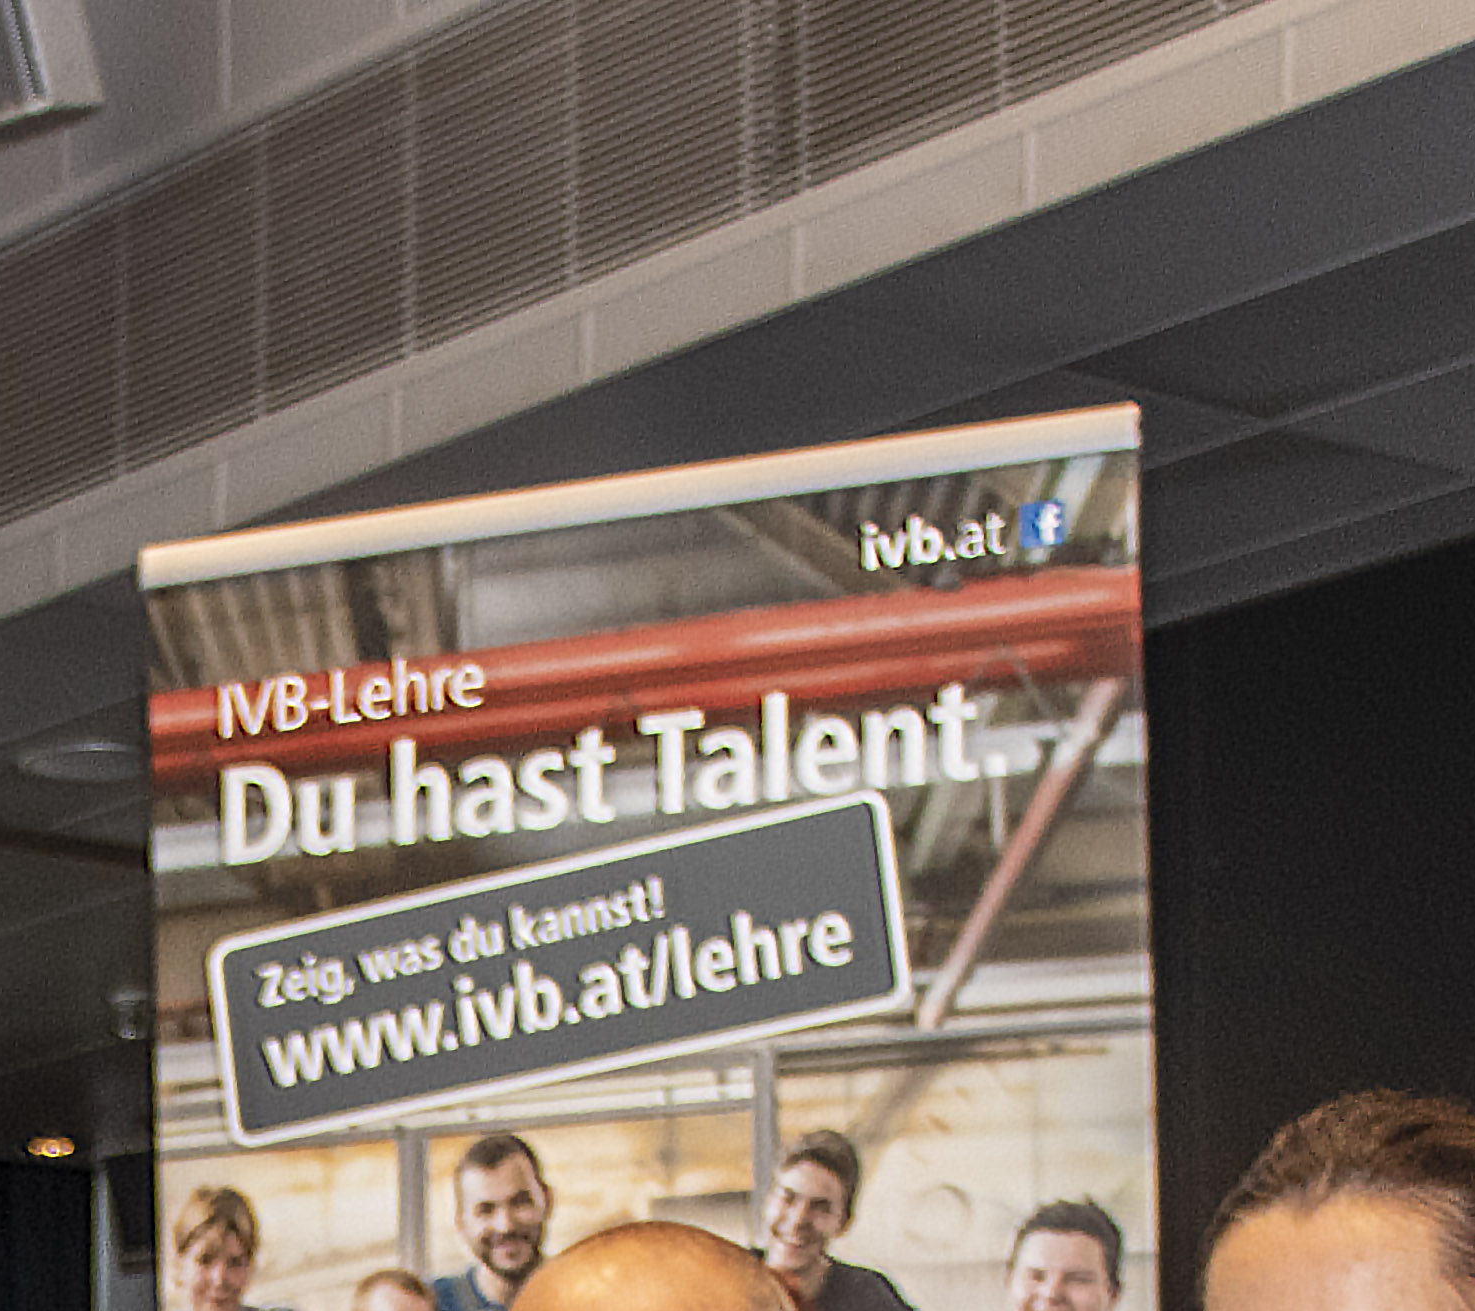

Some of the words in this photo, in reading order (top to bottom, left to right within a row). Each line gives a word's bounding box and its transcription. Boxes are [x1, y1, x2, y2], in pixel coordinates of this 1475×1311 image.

[860, 512, 1007, 571] ivb.at
[218, 657, 486, 739] IVB-Lehre
[220, 762, 356, 866] Du
[390, 726, 618, 846] hast
[636, 682, 1009, 814] Talent.
[256, 951, 355, 1008] Zeig,
[357, 934, 444, 983] was
[449, 915, 506, 963] du
[507, 875, 665, 950] kannst!
[261, 909, 854, 1088] www.ivb.at/lehre
